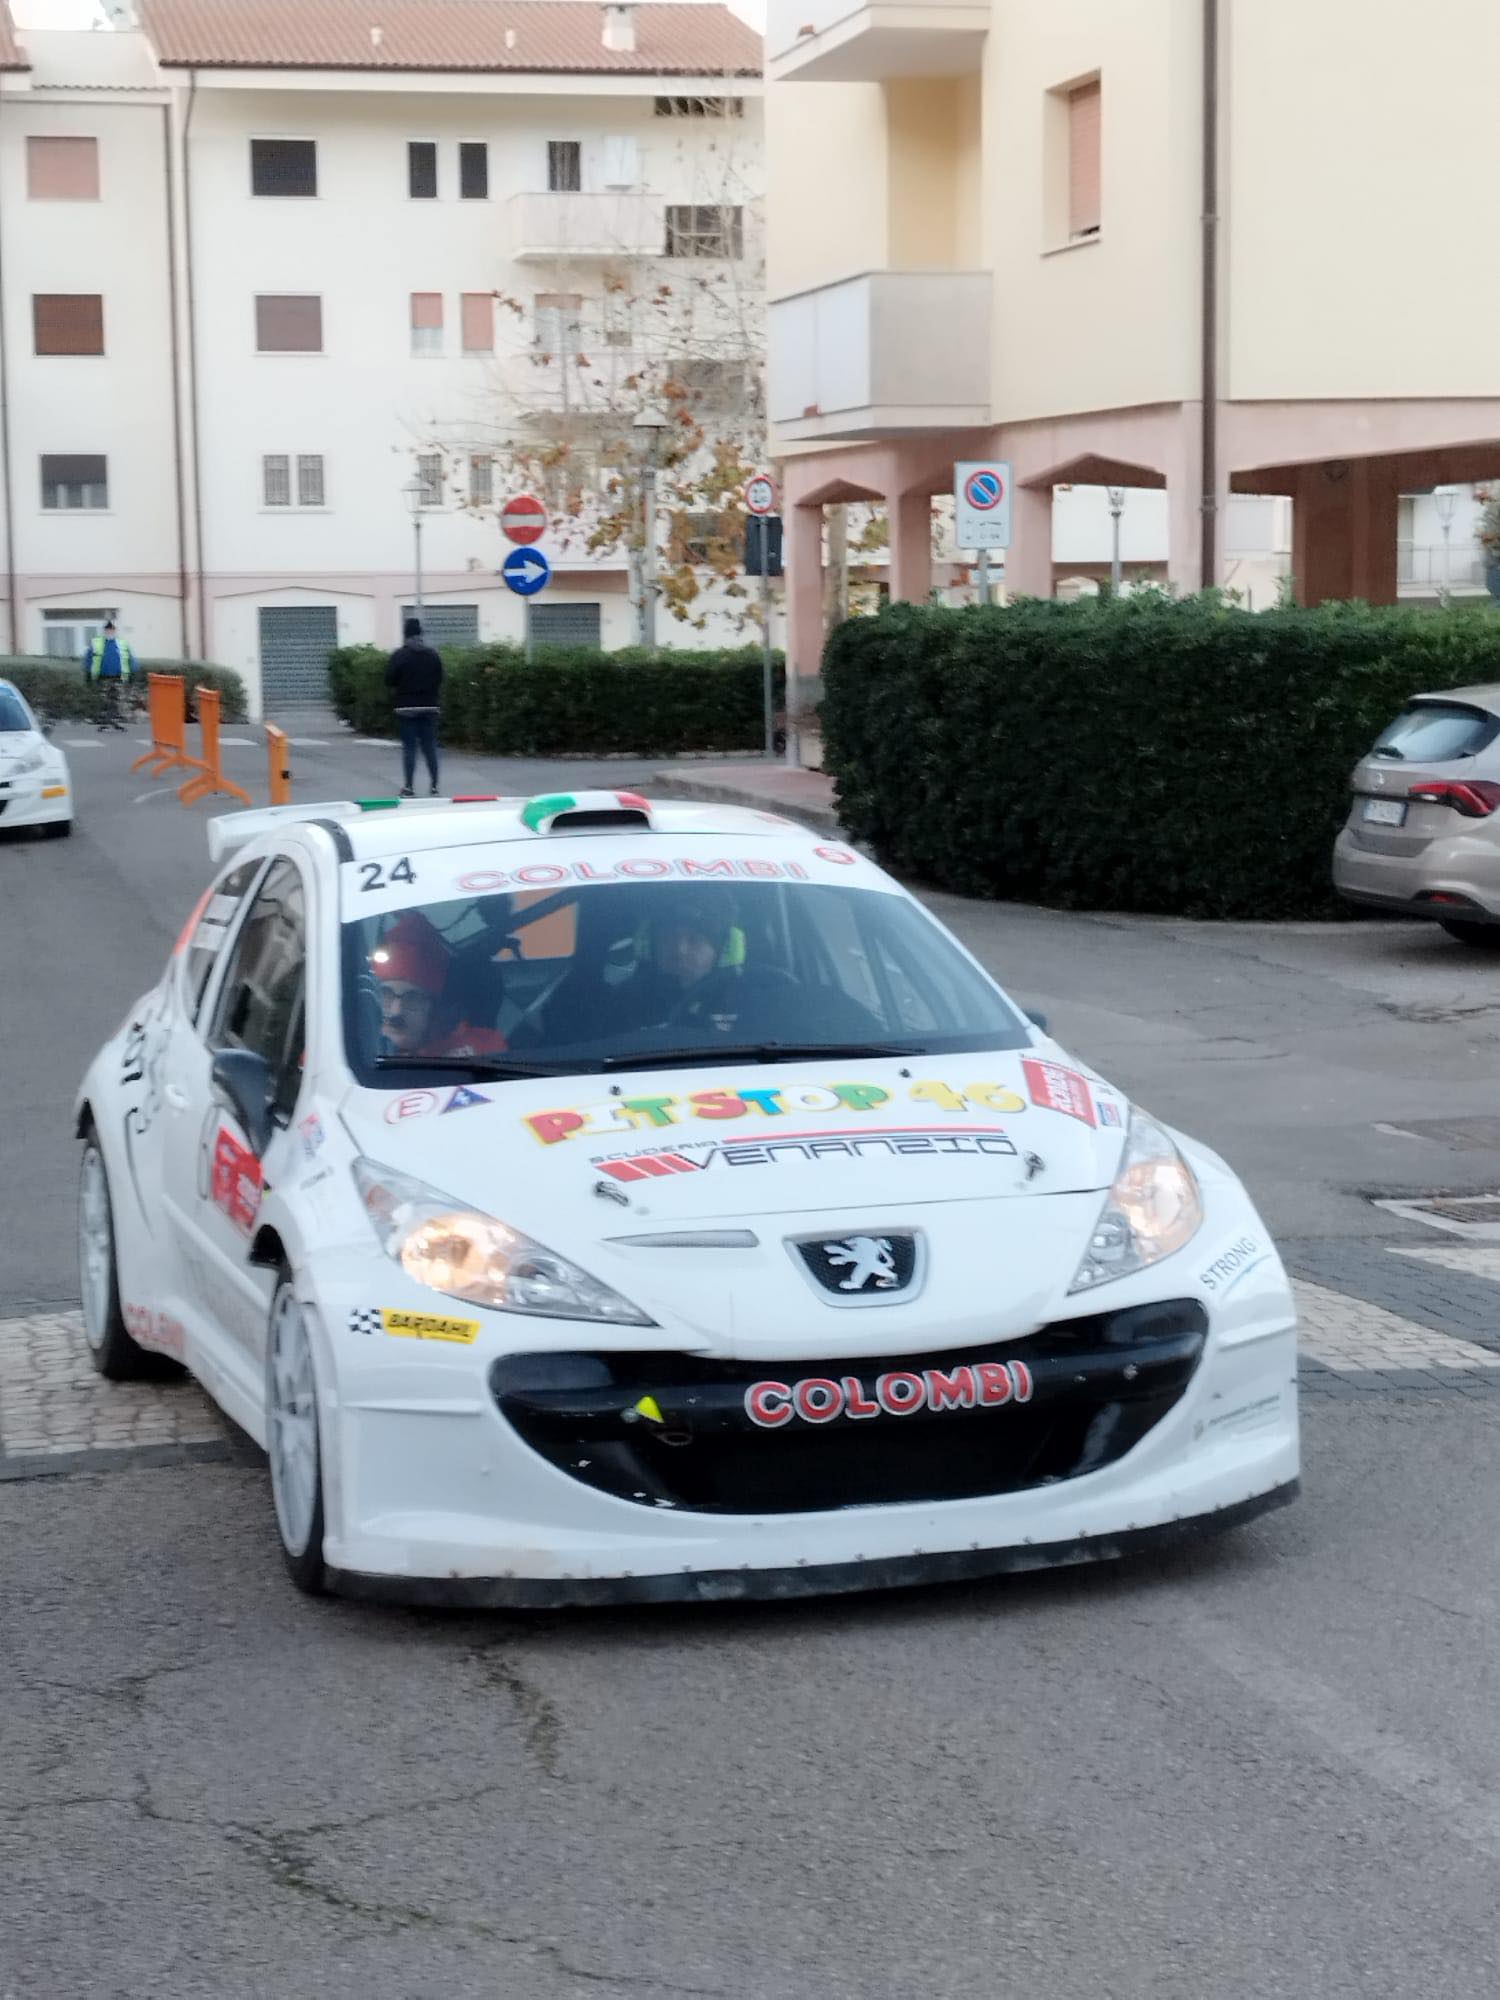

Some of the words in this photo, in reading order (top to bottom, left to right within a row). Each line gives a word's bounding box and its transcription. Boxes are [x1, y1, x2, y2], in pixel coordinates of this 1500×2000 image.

[360, 856, 416, 893] 24
[455, 856, 809, 894] COLOMBI
[907, 1080, 1027, 1114] 46
[589, 1140, 718, 1164] SCUDERIA
[1199, 1237, 1257, 1290] STRONG
[744, 1360, 1034, 1428] COLOMBI
